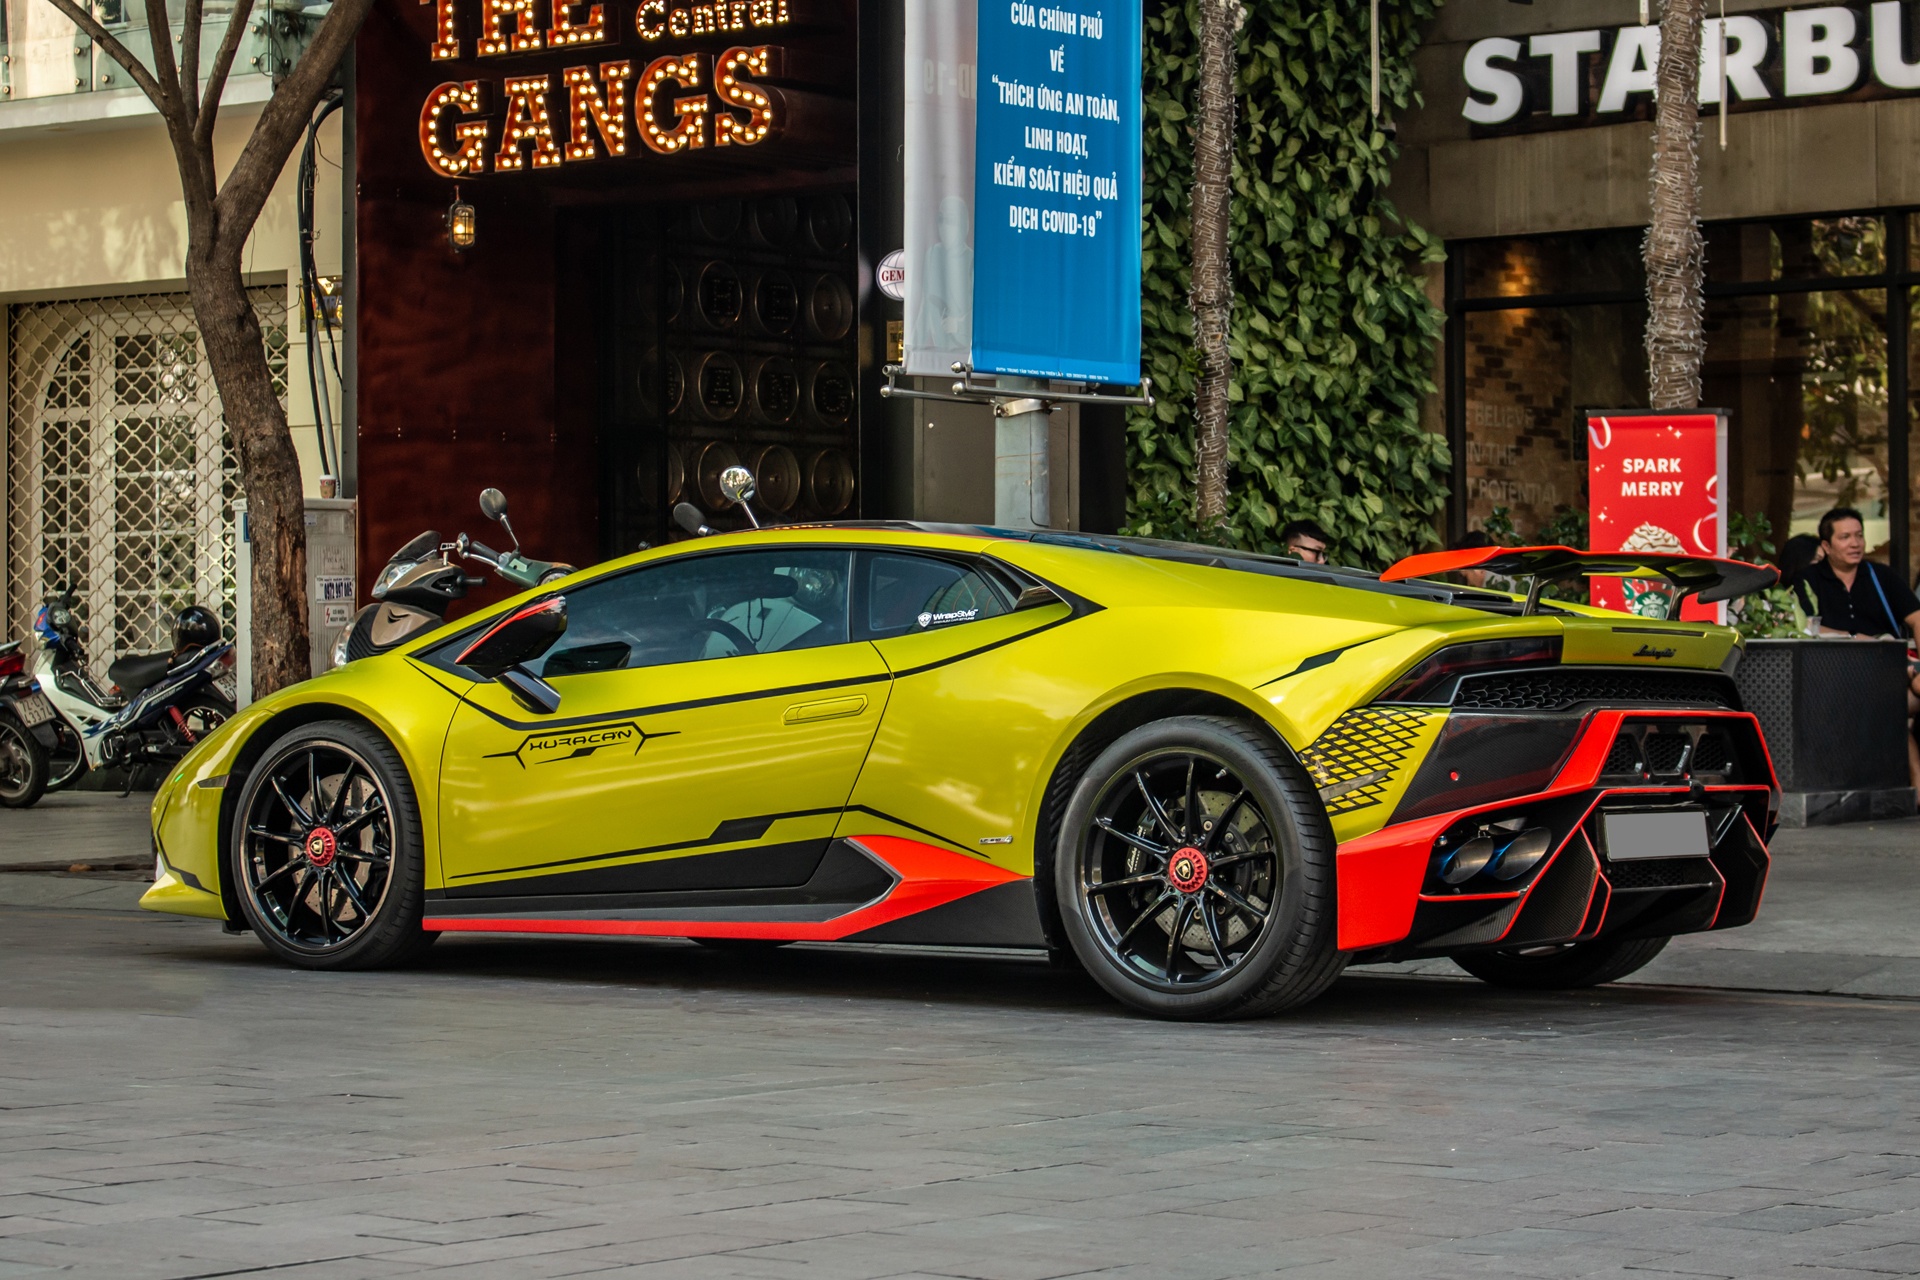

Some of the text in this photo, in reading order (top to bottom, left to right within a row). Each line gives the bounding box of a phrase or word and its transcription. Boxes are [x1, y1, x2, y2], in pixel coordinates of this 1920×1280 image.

[1039, 6, 1077, 36] CHÍNH
[1080, 11, 1103, 40] PHỦ
[1050, 45, 1065, 73] VỀ
[419, 46, 773, 178] GANGS
[1038, 84, 1063, 113] ỨNG
[1066, 92, 1084, 116] AN
[1087, 95, 1120, 124] TOÀN,
[1025, 126, 1089, 160] LINH HOẠT,
[994, 156, 1118, 201] KIỂM SOÁT HIỆU QUẢ
[1009, 205, 1039, 233] DỊCH
[1622, 457, 1682, 474] SPARK
[1621, 481, 1684, 497] MERRY
